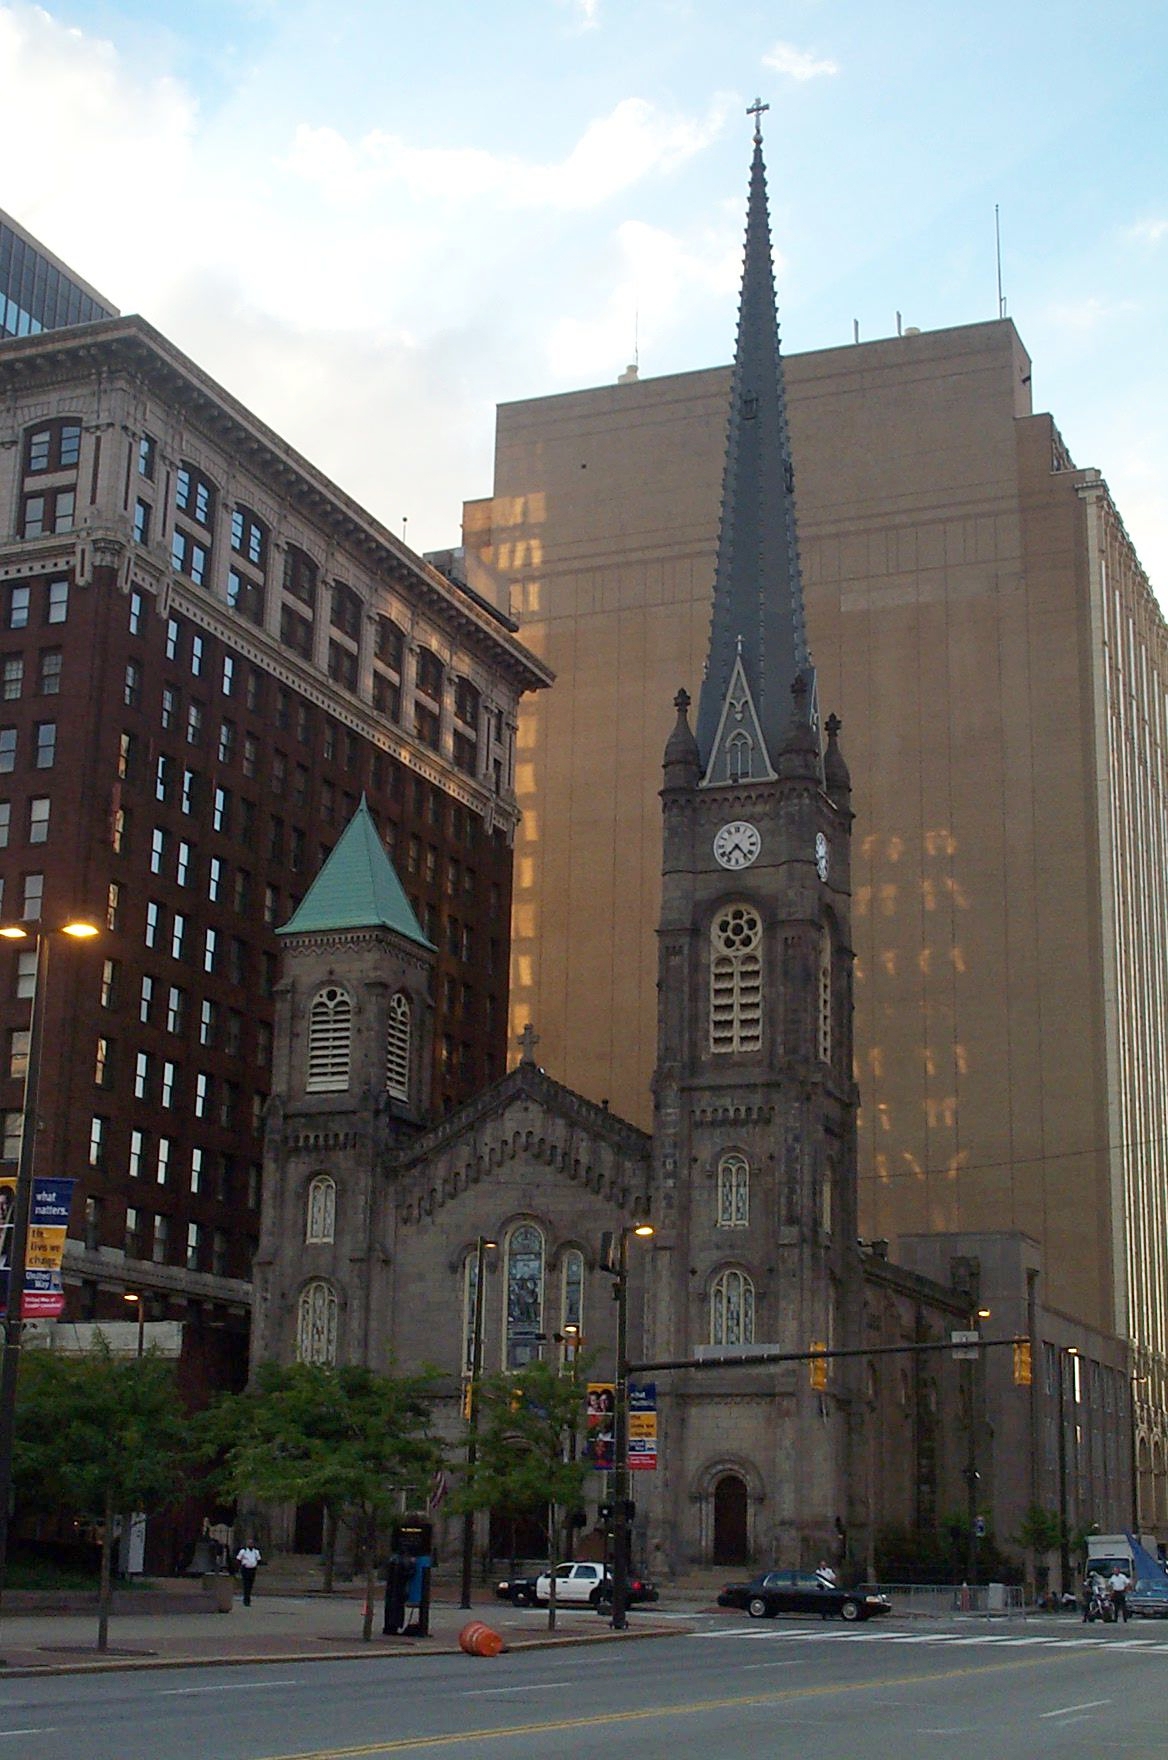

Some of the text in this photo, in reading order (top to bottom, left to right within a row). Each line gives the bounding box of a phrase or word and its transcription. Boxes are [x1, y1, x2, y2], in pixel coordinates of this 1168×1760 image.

[36, 1191, 56, 1202] what
[35, 1205, 69, 1216] matters.
[25, 1271, 51, 1281] United
[34, 1280, 50, 1290] Way
